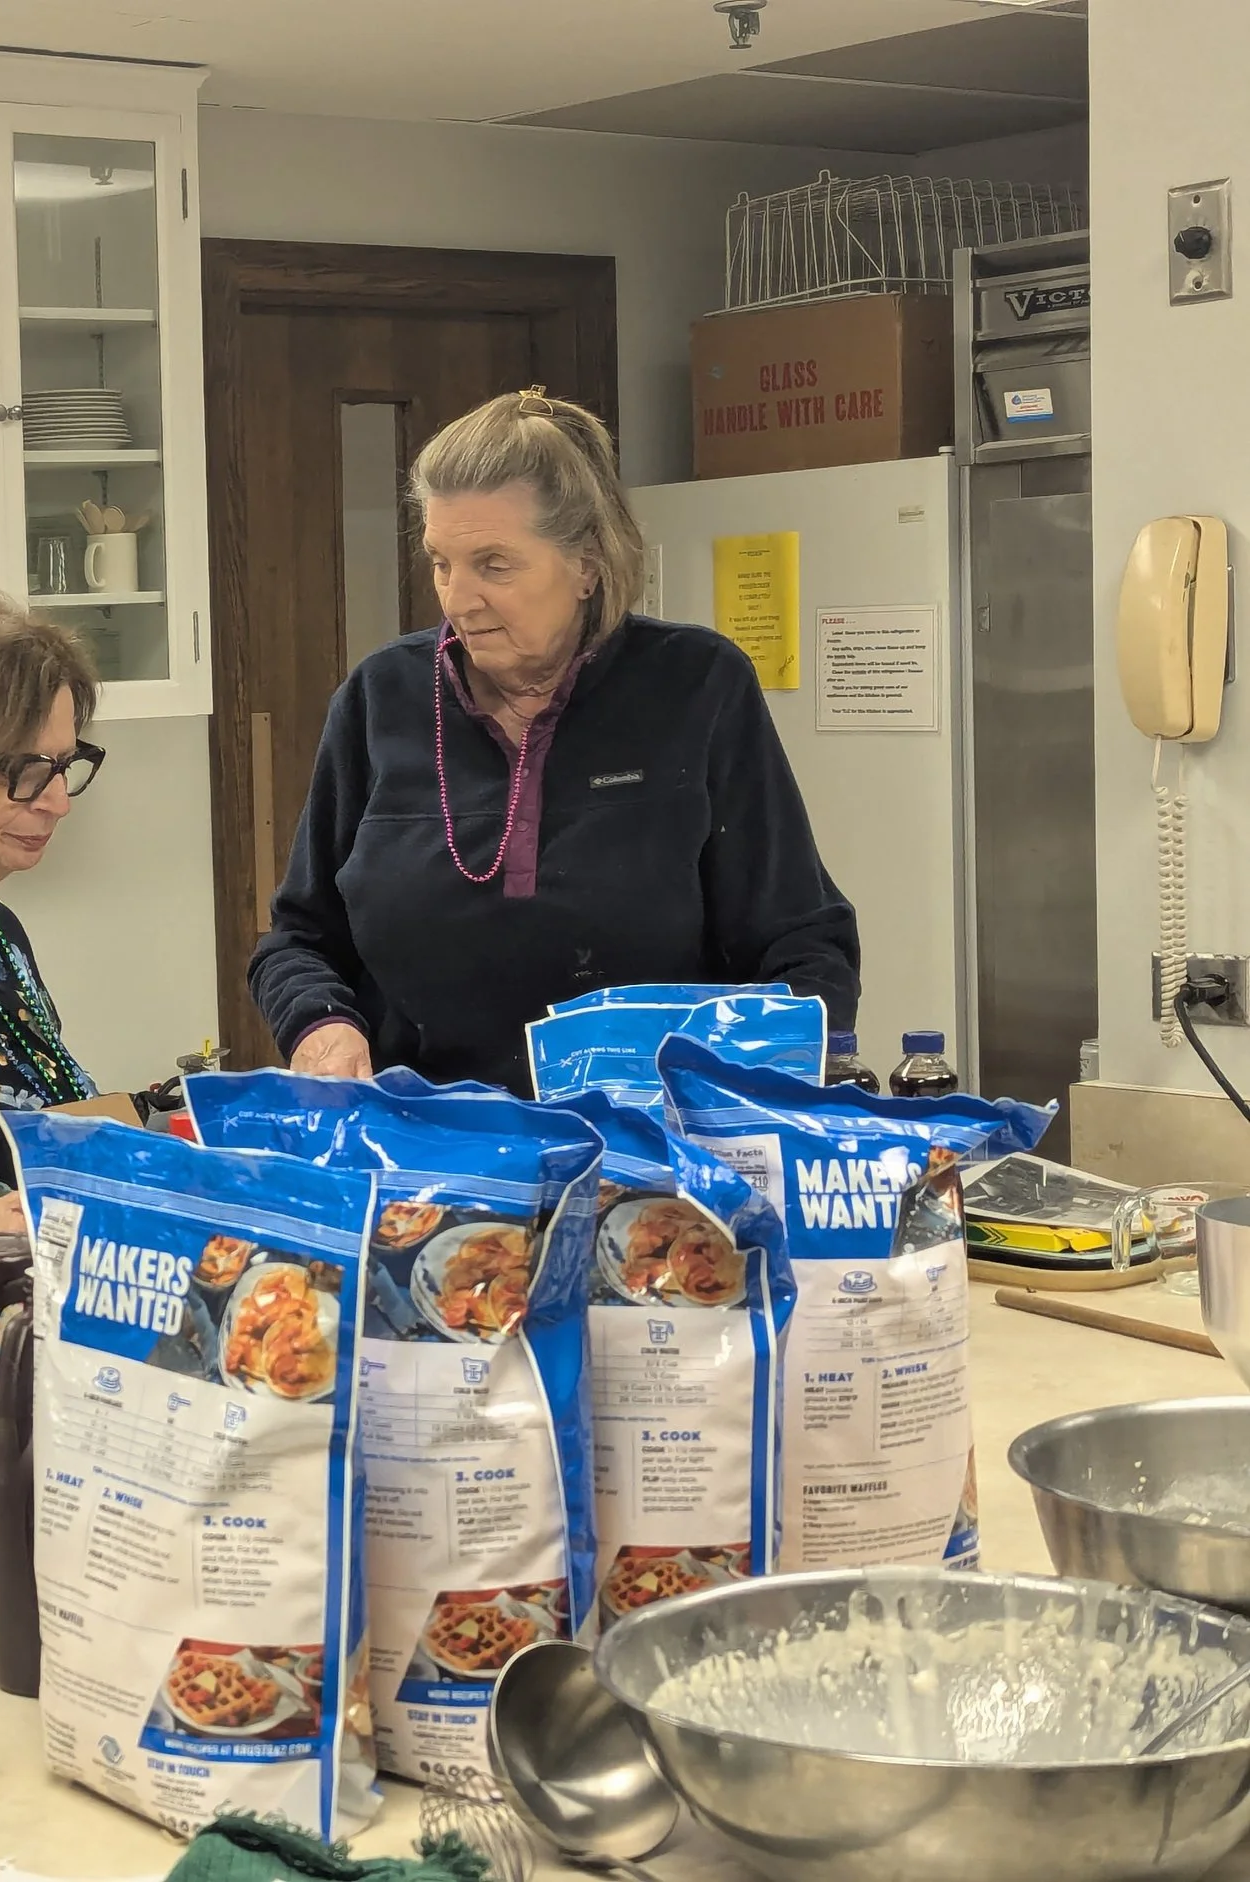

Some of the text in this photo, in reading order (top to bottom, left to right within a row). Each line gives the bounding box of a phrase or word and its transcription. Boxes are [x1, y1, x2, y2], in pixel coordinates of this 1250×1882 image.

[1006, 288, 1090, 317] VICT
[760, 359, 818, 392] GLASS
[704, 389, 883, 436] HANDLE WITH CARE
[799, 1194, 902, 1229] WANT
[79, 1236, 192, 1298] MAKERS
[75, 1275, 184, 1336] WANTED
[804, 1372, 854, 1383] 1. HEAT
[894, 1362, 928, 1376] WHISK
[642, 1431, 701, 1441] 3. COOK
[56, 1471, 84, 1488] HEAT
[455, 1468, 515, 1482] 3. COOK
[803, 1480, 888, 1496] FAVORITE WAFFLES
[115, 1491, 143, 1509] WHISK
[203, 1515, 266, 1528] 3. COOK
